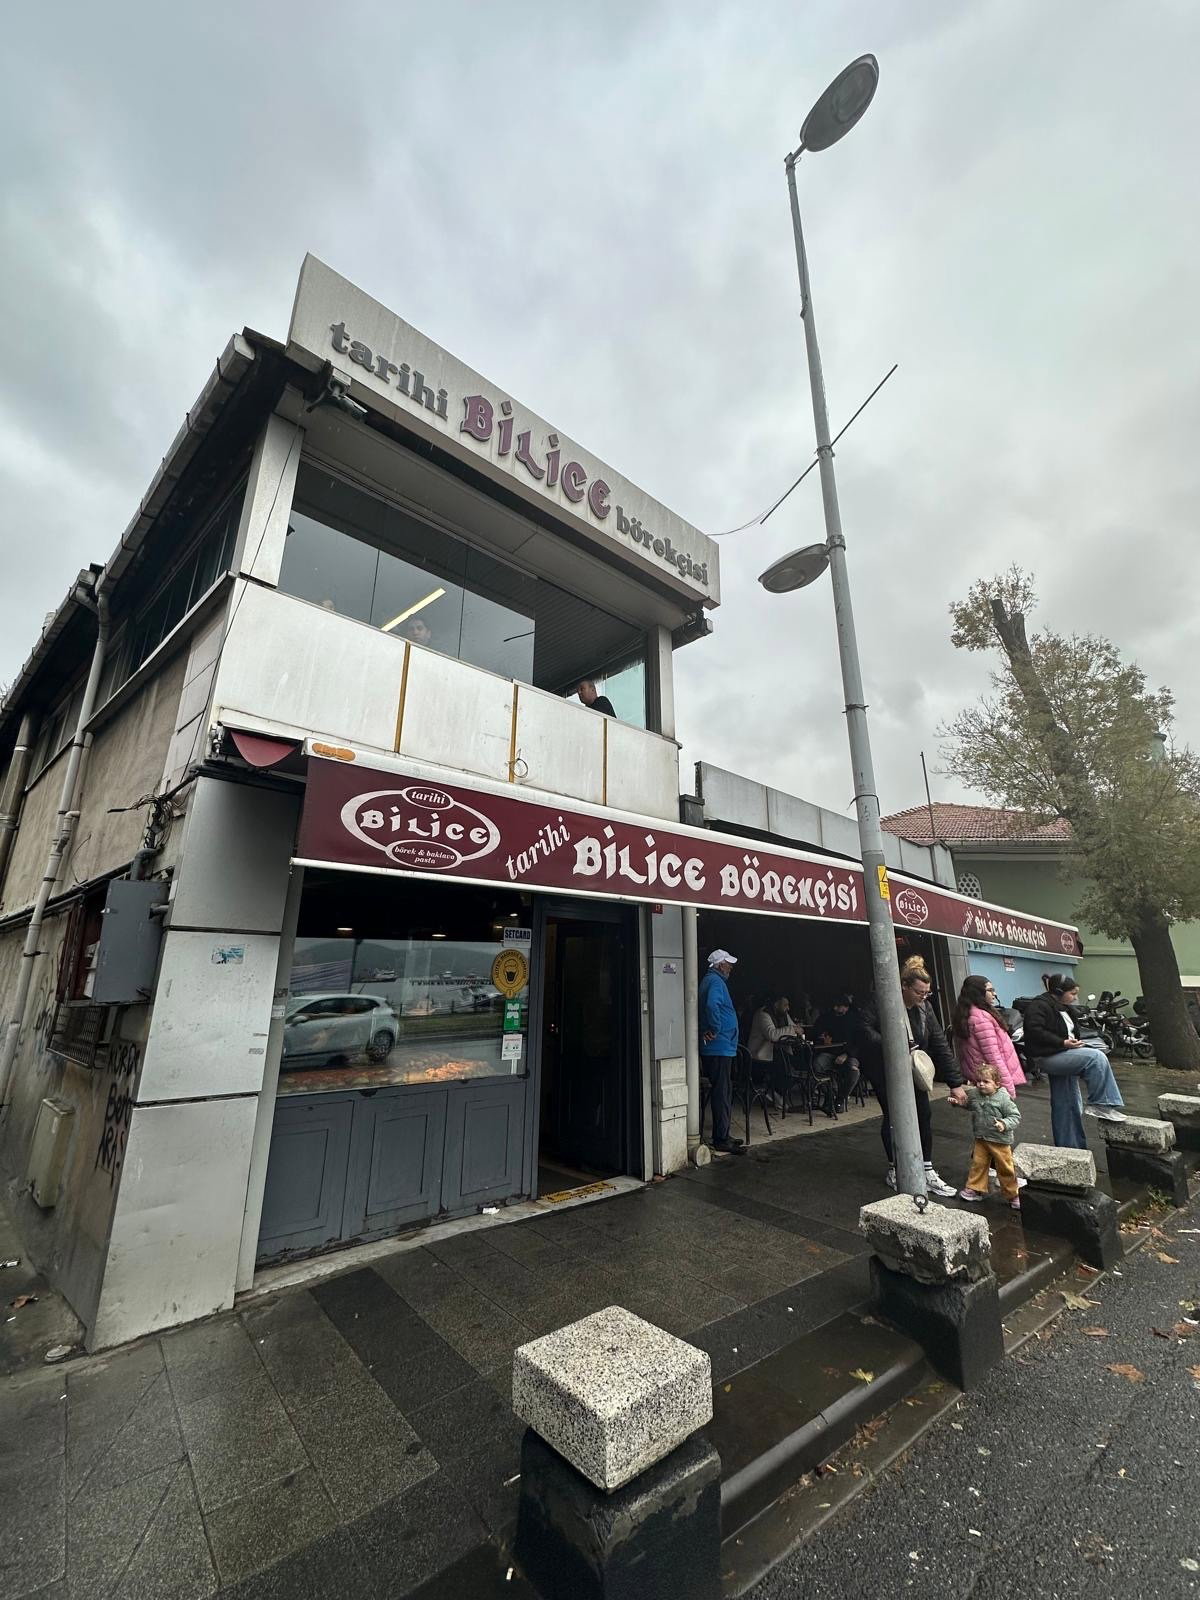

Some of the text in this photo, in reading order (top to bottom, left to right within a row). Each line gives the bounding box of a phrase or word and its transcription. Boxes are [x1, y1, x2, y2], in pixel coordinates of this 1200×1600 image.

[330, 321, 449, 420] tarihi
[616, 505, 709, 586] börekçisi
[411, 790, 446, 805] tarihi
[394, 845, 417, 856] börek
[426, 850, 455, 860] baklava
[505, 815, 571, 880] tarihi
[414, 856, 436, 865] pasta
[504, 929, 531, 940] SETCARD
